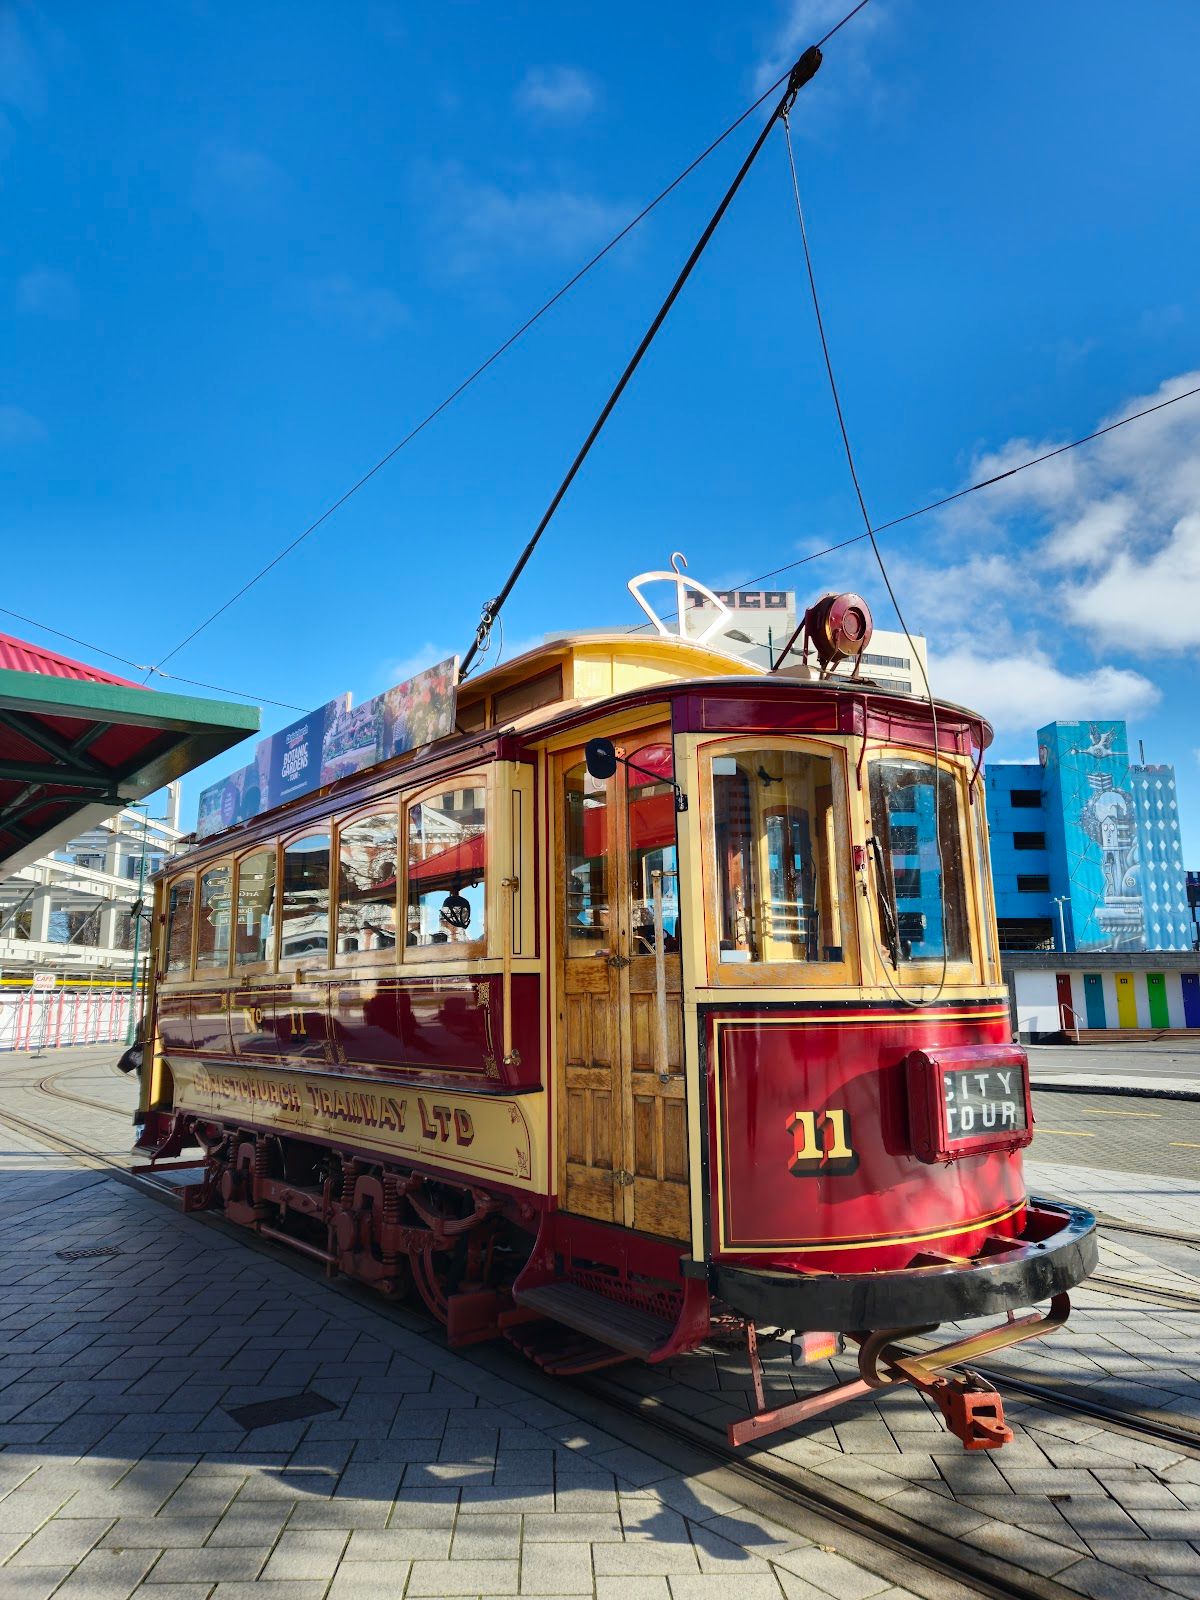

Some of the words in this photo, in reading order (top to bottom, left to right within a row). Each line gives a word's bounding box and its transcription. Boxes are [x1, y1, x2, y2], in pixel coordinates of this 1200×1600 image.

[281, 753, 309, 778] GARDENS
[283, 741, 309, 766] BOTANIC
[289, 1007, 307, 1035] 11
[943, 1071, 1012, 1102] CITY
[193, 1072, 303, 1112] CHRISTCHURCH
[307, 1086, 408, 1132] TRAMWAY
[417, 1097, 476, 1147] LTD
[945, 1101, 1017, 1134] TOUR
[786, 1108, 856, 1168] 11
